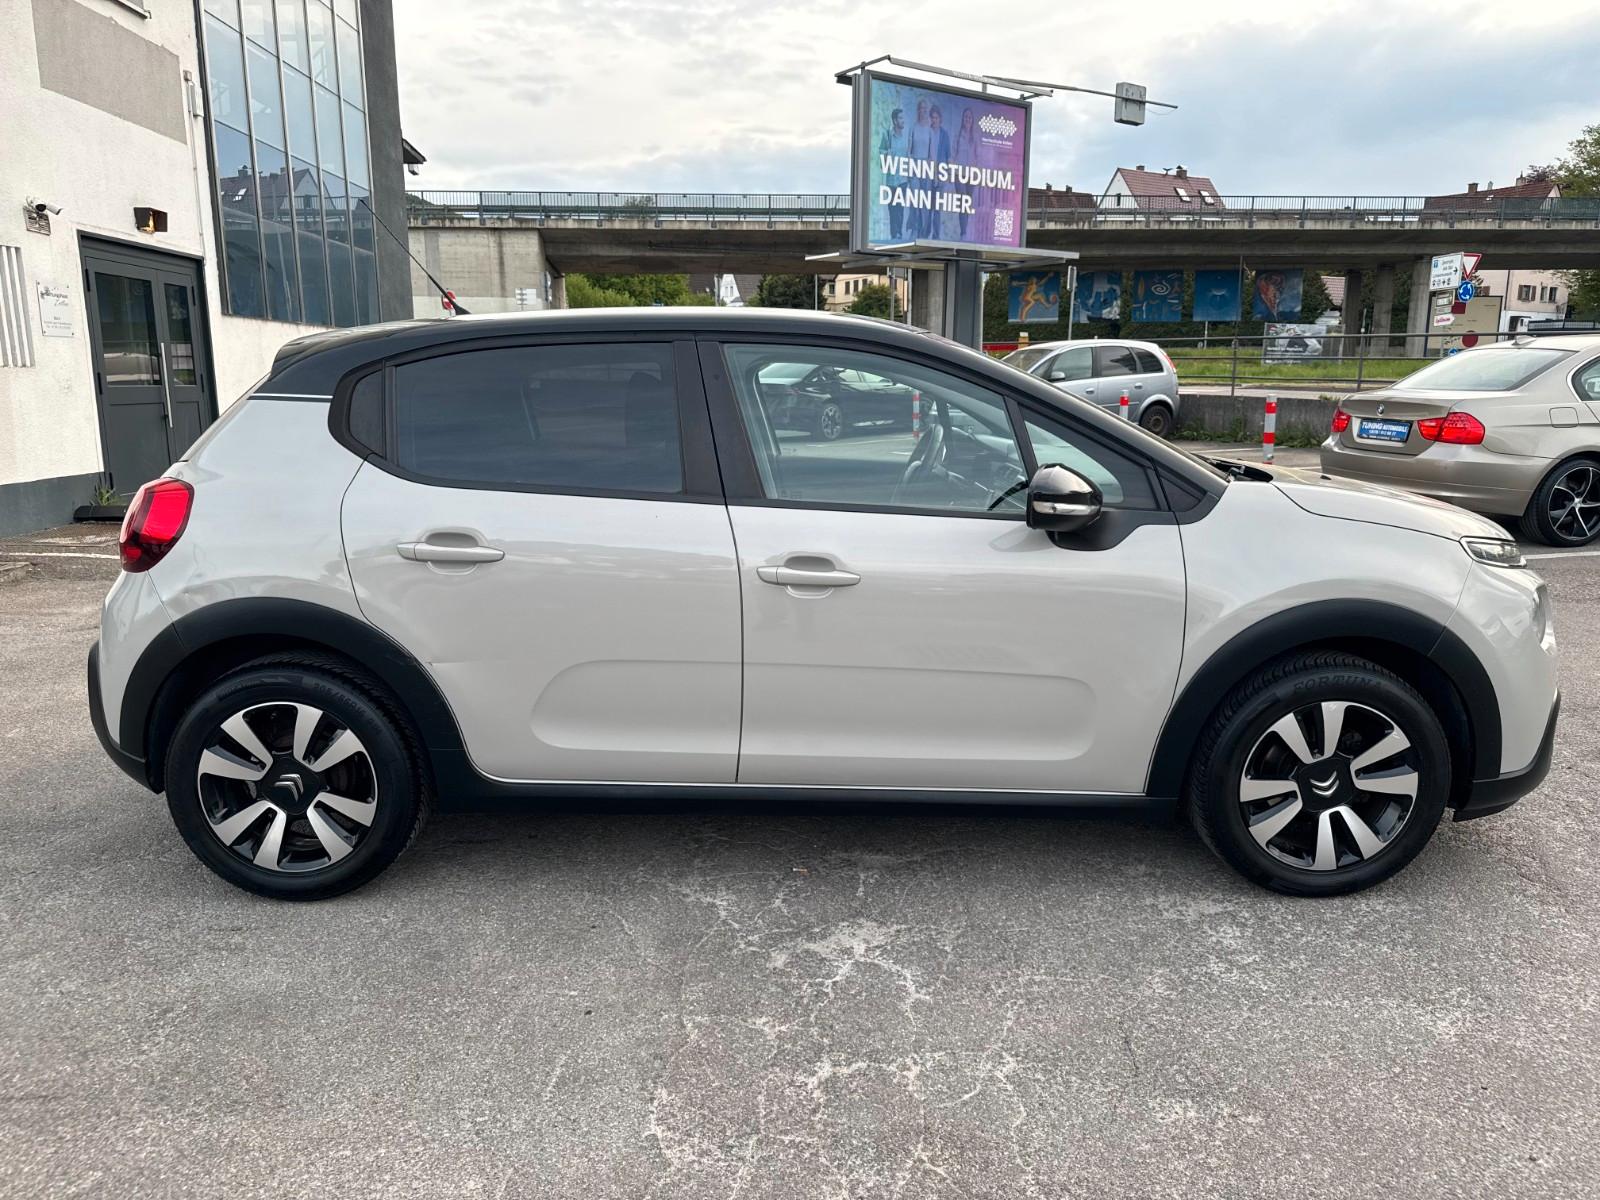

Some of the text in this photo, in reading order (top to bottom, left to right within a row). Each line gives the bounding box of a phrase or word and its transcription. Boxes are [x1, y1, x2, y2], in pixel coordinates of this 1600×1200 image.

[879, 153, 1016, 191] WENN STUDIUM.
[879, 185, 976, 215] DANN HIER.
[1361, 421, 1383, 430] TUNING
